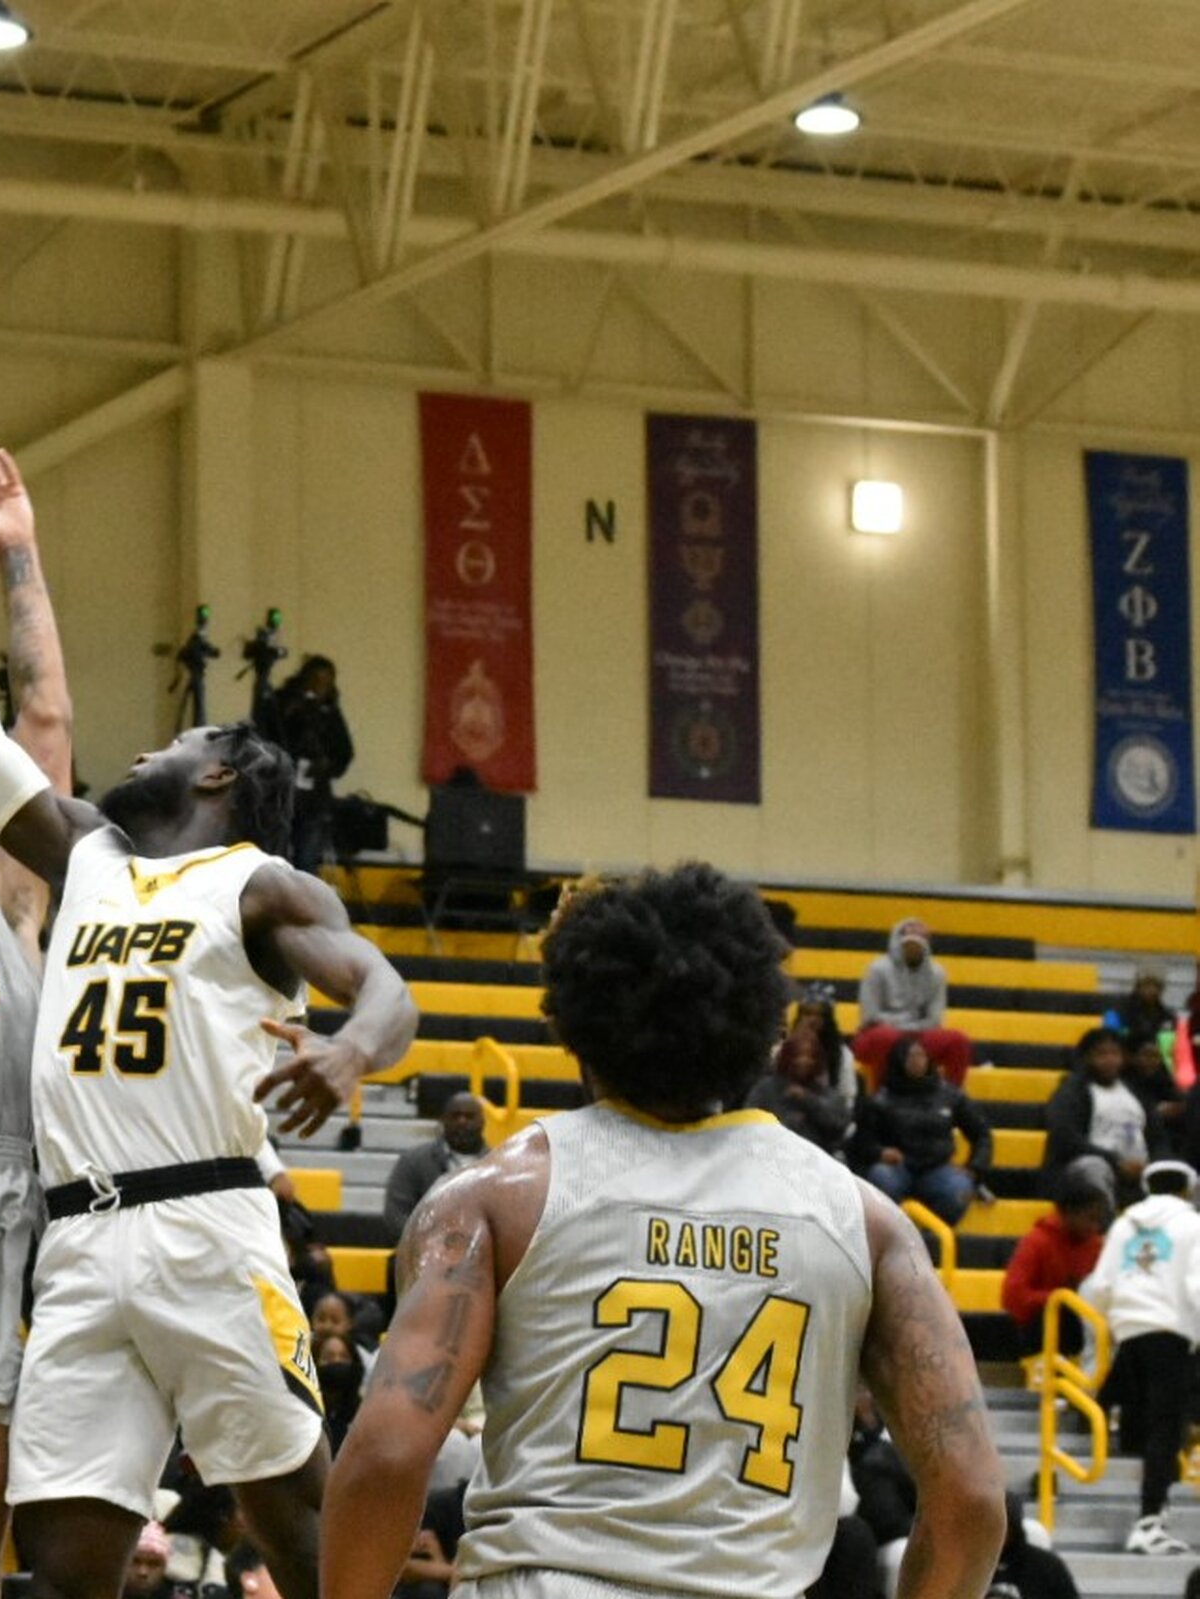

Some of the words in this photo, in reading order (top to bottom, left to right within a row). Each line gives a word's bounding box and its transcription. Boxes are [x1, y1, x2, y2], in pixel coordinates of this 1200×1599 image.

[586, 499, 615, 543] N
[66, 920, 196, 967] UAPB
[59, 977, 173, 1077] 45
[647, 1218, 780, 1277] RANGE
[576, 1277, 811, 1498] 24
